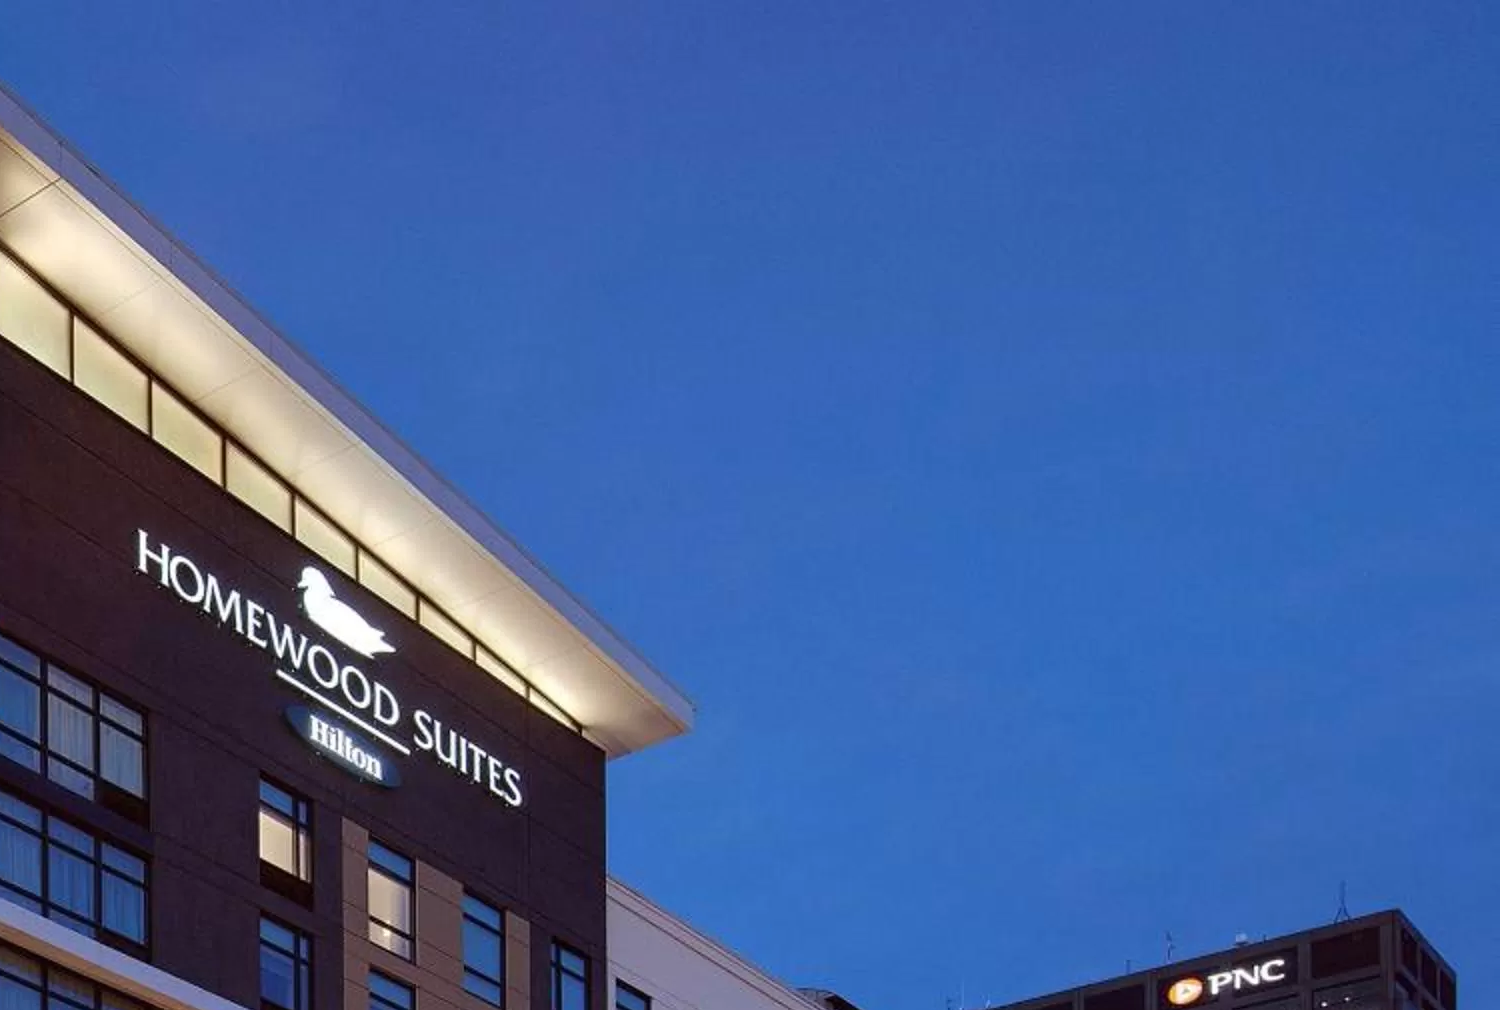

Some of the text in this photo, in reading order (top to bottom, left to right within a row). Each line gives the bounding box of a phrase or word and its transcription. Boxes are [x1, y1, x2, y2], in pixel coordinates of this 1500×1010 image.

[136, 529, 523, 807] HOMEWOOD SUITES
[310, 714, 382, 780] Hilton
[1208, 959, 1285, 995] PNC
